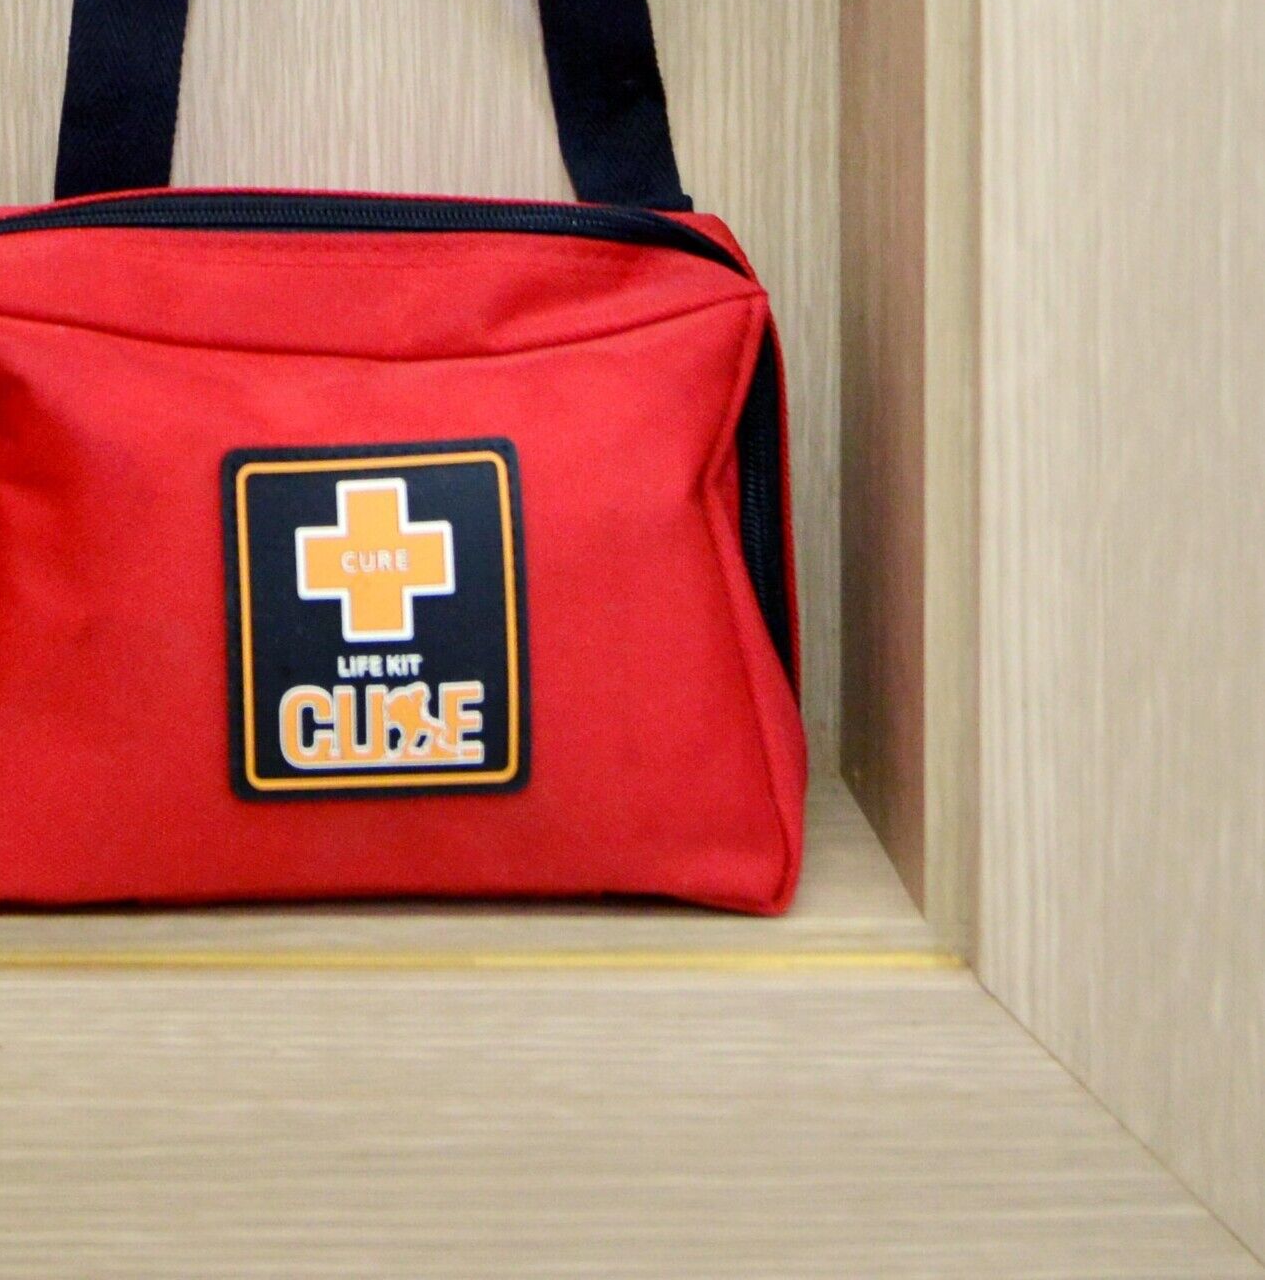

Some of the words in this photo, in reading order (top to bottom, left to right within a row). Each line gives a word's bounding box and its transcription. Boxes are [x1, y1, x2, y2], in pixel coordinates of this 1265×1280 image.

[340, 548, 410, 574] CURE
[337, 655, 384, 679] LIFE
[386, 652, 424, 677] KIT
